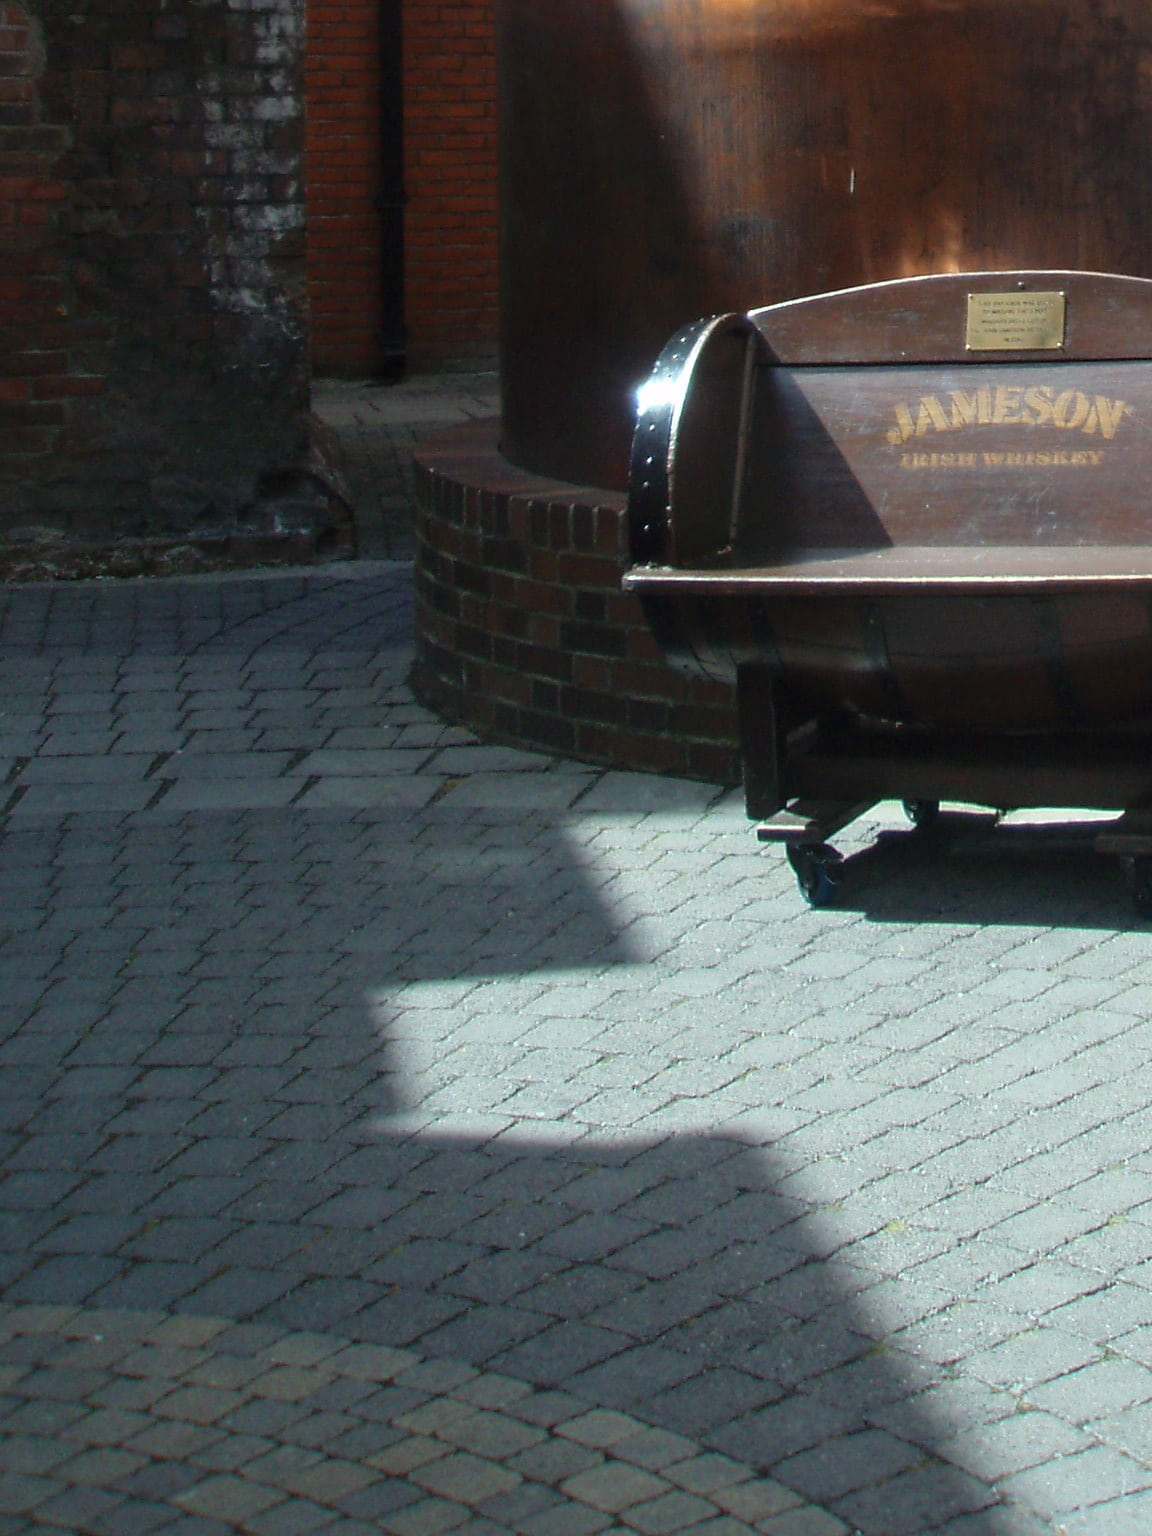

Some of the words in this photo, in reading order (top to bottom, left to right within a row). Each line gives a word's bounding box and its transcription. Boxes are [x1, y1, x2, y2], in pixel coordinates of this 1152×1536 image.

[886, 384, 1134, 445] JAMESON
[898, 452, 978, 469] IRISH
[983, 451, 1105, 467] WHISKEY
